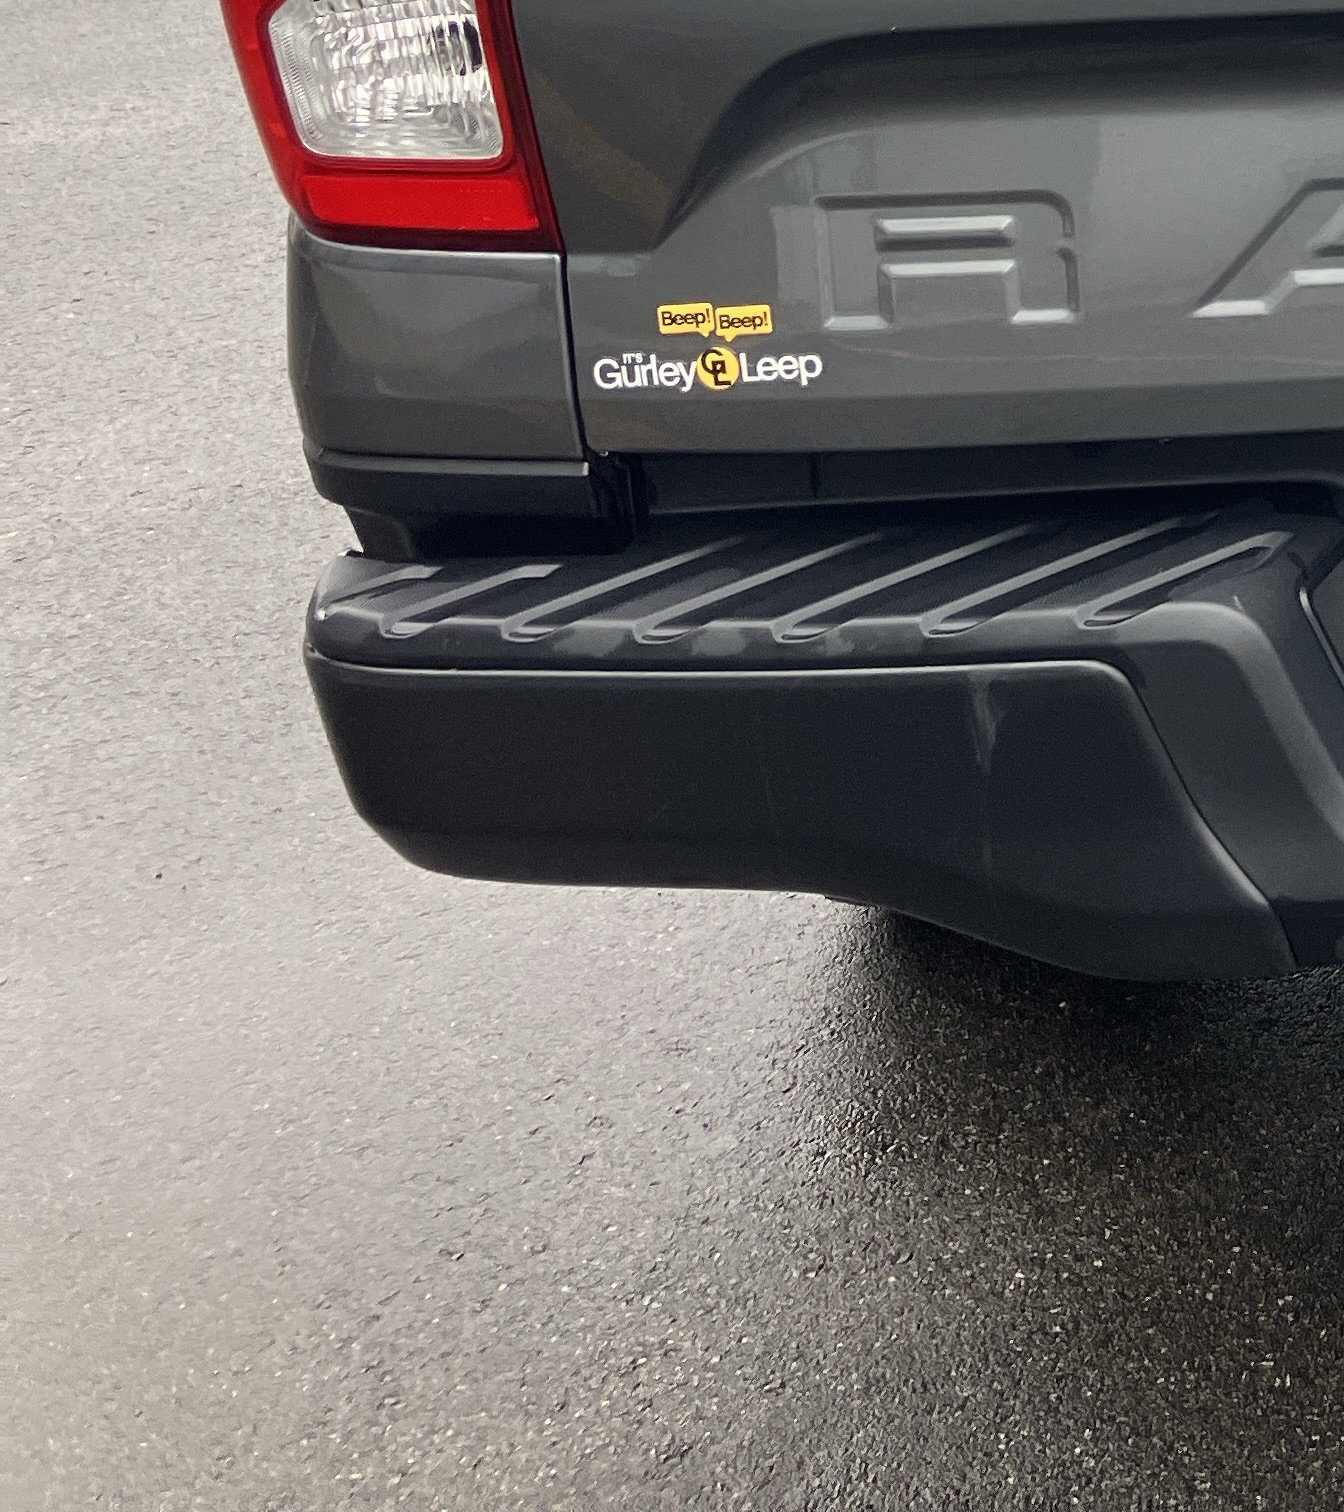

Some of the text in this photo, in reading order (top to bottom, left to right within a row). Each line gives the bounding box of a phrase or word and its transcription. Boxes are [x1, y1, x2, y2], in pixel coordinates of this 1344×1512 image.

[661, 308, 769, 330] Beep! Beep!
[593, 354, 697, 392] Gurley
[738, 352, 823, 386] Leep
